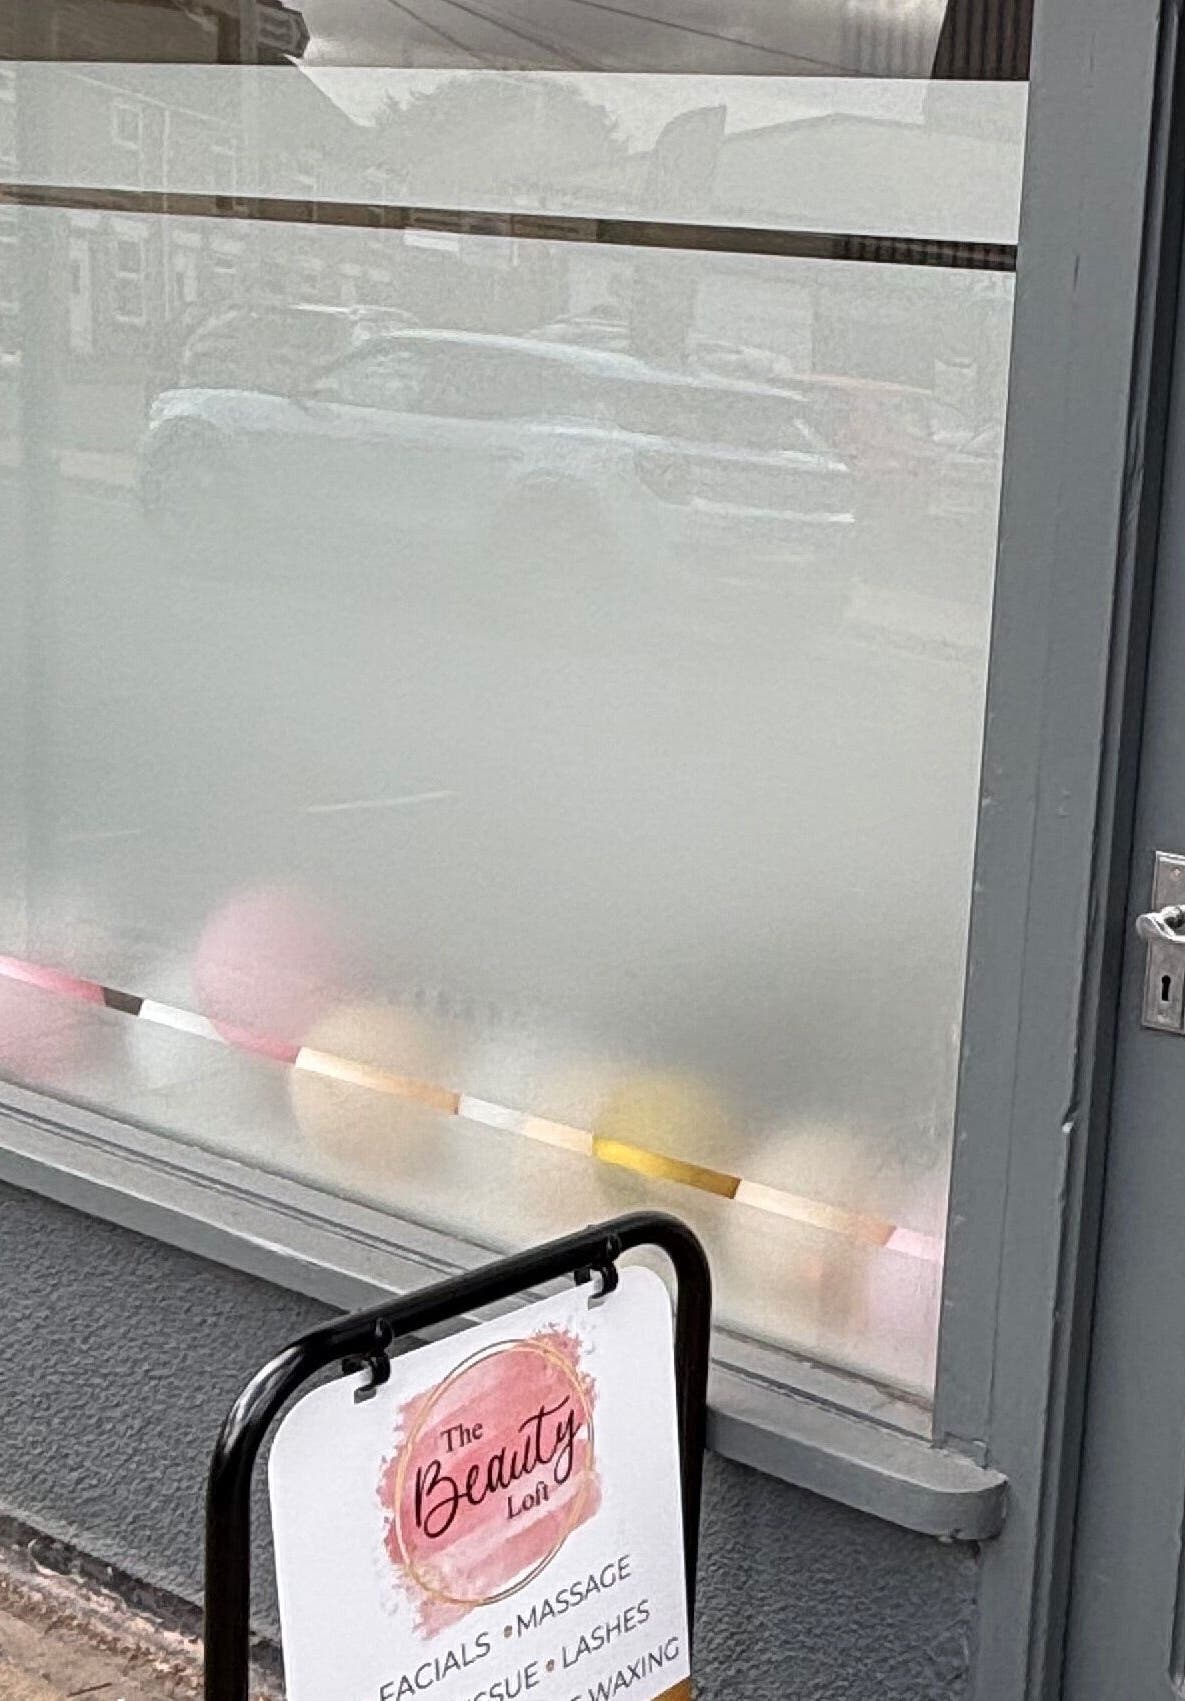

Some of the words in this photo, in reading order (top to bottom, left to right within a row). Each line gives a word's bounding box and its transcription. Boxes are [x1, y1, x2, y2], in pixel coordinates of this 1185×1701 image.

[415, 1395, 583, 1538] Beauty
[440, 1423, 483, 1453] The
[507, 1480, 549, 1519] Loft
[379, 1632, 491, 1701] FACIALS
[516, 1555, 631, 1637] MASSAGE
[562, 1599, 650, 1668] LASHES
[588, 1636, 679, 1701] WAXING
